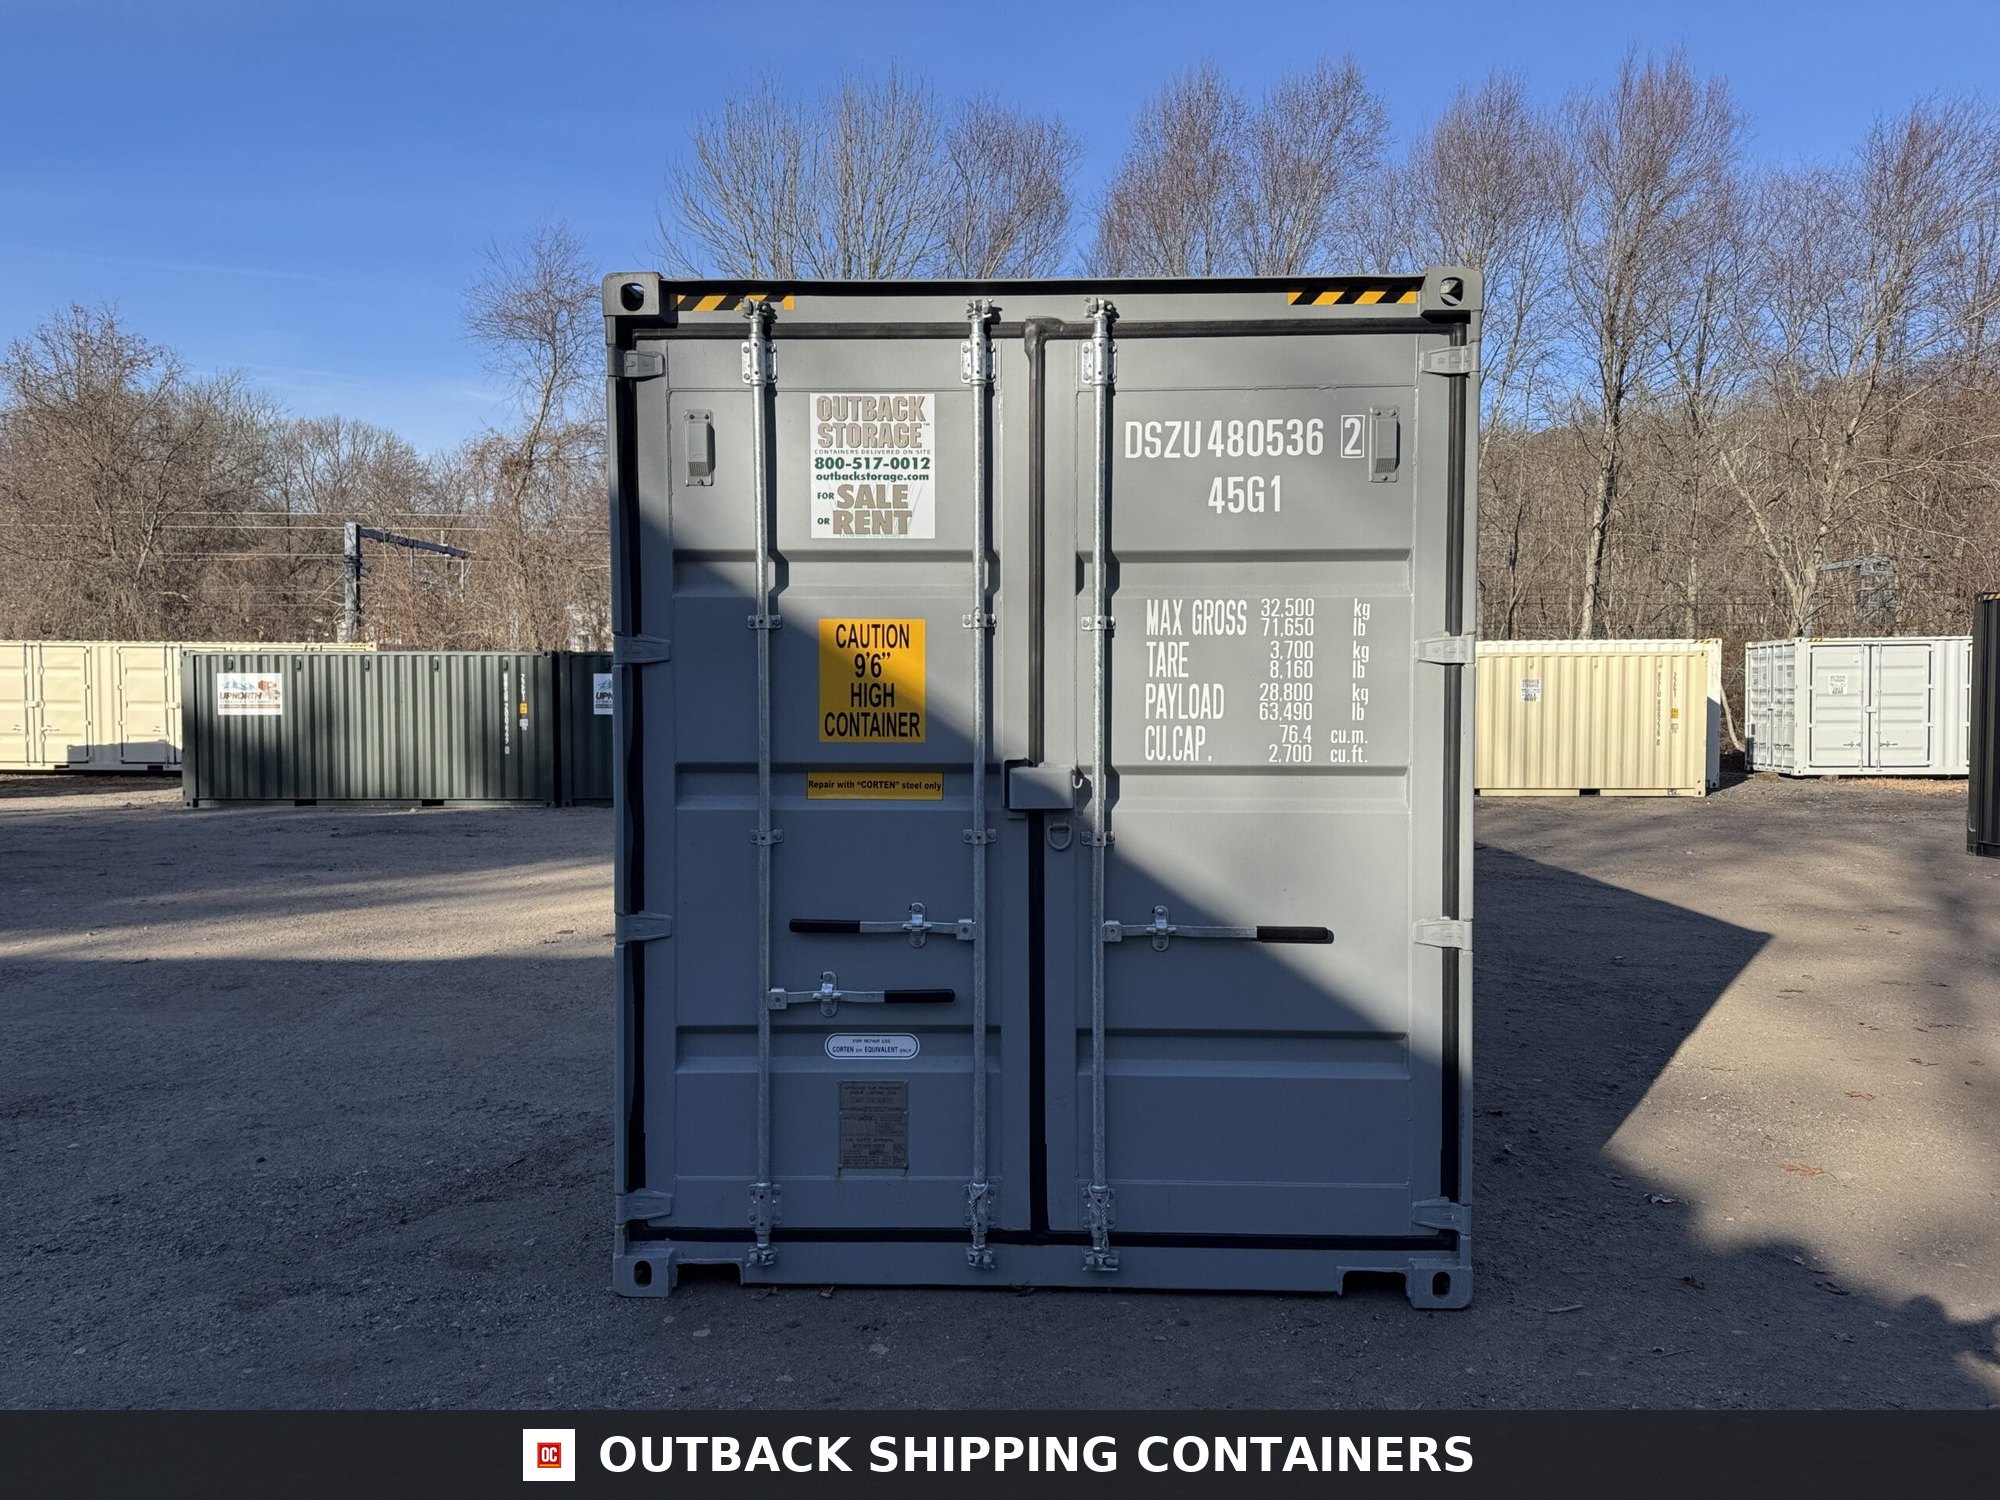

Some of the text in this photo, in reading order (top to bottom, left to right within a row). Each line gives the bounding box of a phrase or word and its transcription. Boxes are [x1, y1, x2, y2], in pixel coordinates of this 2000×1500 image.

[816, 395, 926, 421] OUTBACK
[817, 422, 922, 448] STORAGE
[1125, 417, 1362, 458] DSZU 480536 2
[814, 457, 930, 469] 800-517-0012
[816, 471, 929, 482] outbackstorage.com
[817, 484, 909, 509] FOR SALE
[1207, 475, 1281, 514] 45G1
[832, 510, 912, 535] RENT
[1146, 599, 1248, 636] MAX GROSS
[1260, 598, 1371, 620] 32,500 kg
[836, 624, 910, 649] CAUTION
[1260, 617, 1366, 637] 71,650 lb
[1146, 641, 1190, 678] TARE
[1270, 640, 1370, 663] 3,700 kg
[1270, 660, 1366, 679] 8,160 lb
[850, 683, 895, 708] HIGH
[1145, 683, 1225, 720] PAYLOAD
[1259, 683, 1369, 705] 28,800 kg
[1259, 702, 1365, 721] 63,490 lb
[824, 712, 921, 737] CONTAINER
[1279, 725, 1368, 744] 76.4 cu.m.
[1268, 744, 1368, 763] 2,700 cu.ft.
[808, 780, 834, 790] Repair
[837, 780, 855, 789] with
[902, 781, 922, 789] steel
[924, 782, 942, 792] only
